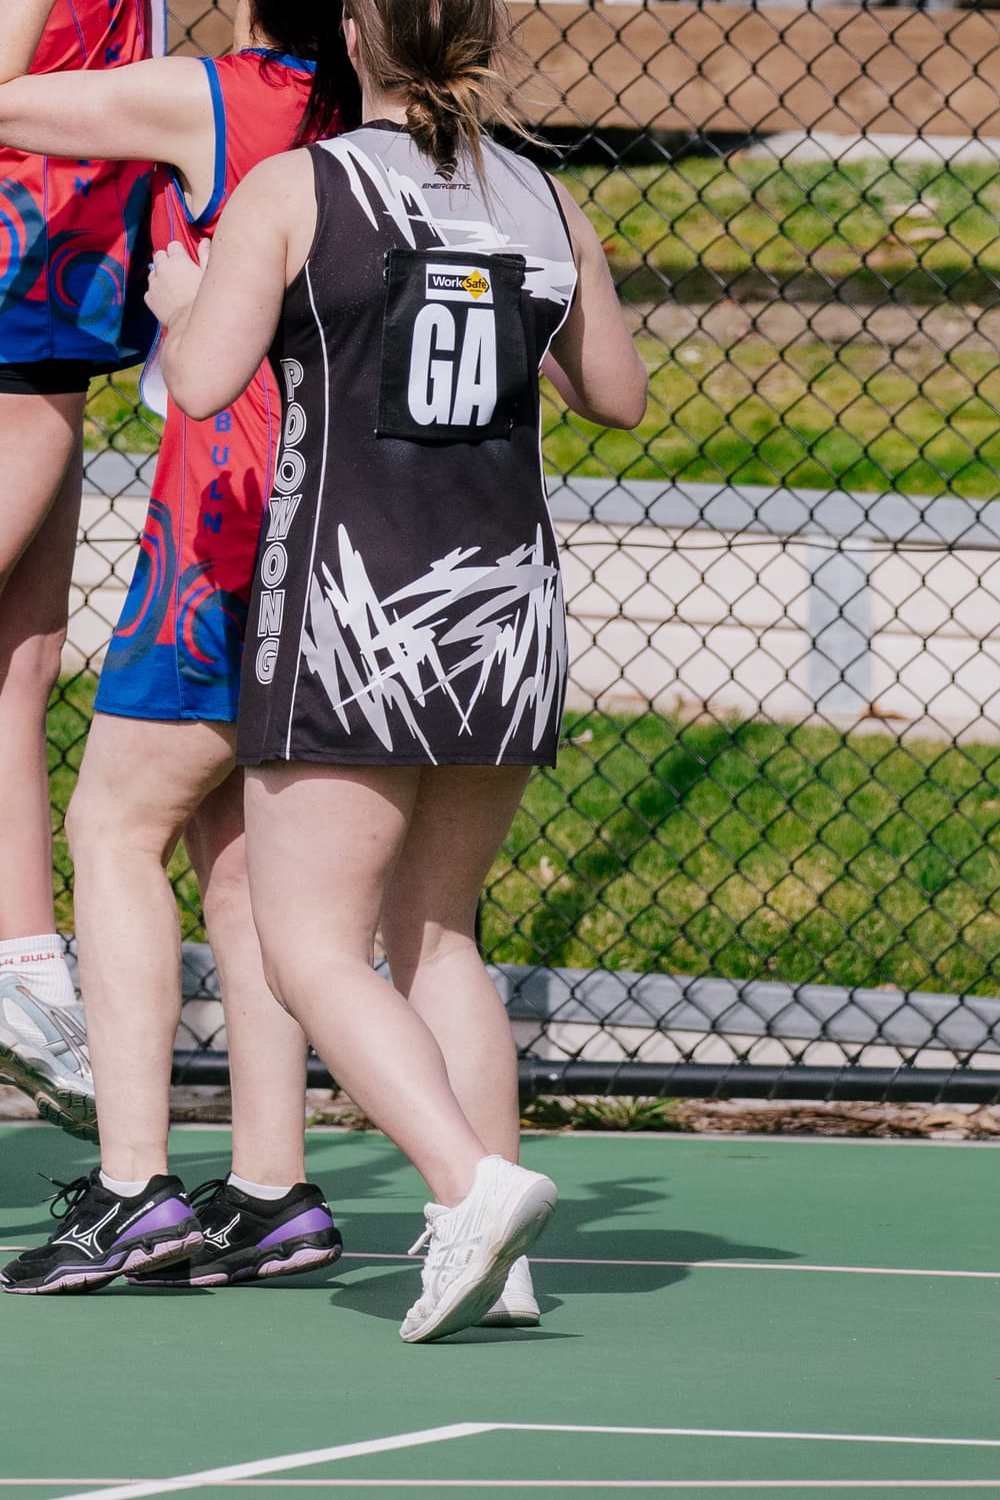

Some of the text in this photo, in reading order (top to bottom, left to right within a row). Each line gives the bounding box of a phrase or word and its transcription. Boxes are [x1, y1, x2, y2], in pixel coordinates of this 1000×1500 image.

[421, 182, 472, 190] ENERGETIC
[407, 303, 498, 426] GA
[203, 411, 233, 535] BULN
[255, 358, 308, 685] POOWONG
